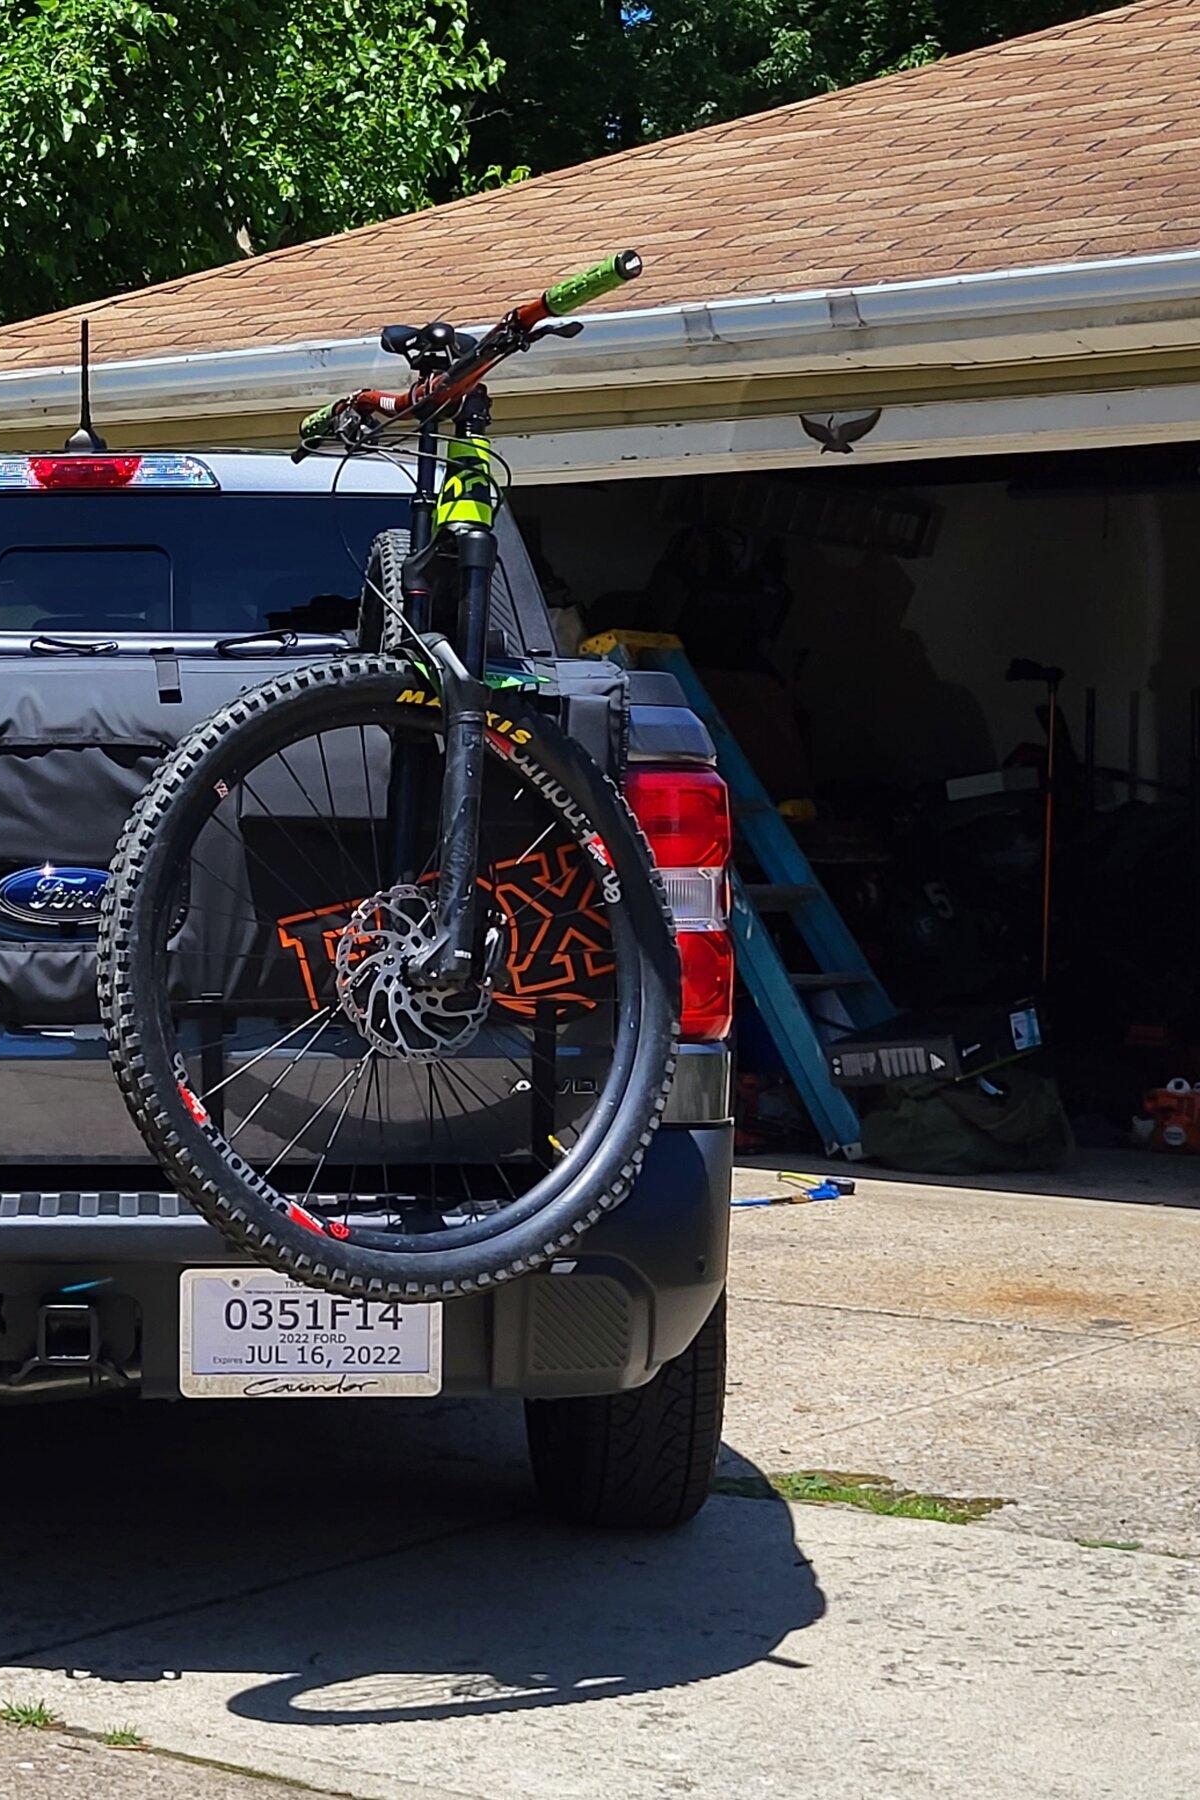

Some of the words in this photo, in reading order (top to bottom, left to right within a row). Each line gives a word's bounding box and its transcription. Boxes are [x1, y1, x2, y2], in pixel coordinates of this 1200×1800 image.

[395, 689, 533, 745] MAXIS
[28, 876, 105, 909] Ford
[224, 1298, 403, 1331] 0351F14
[279, 1333, 309, 1344] 2022
[313, 1333, 347, 1344] FORD
[213, 1355, 243, 1365] Expires
[245, 1345, 287, 1365] JUL
[296, 1345, 333, 1369] 16,
[342, 1345, 402, 1365] 2022
